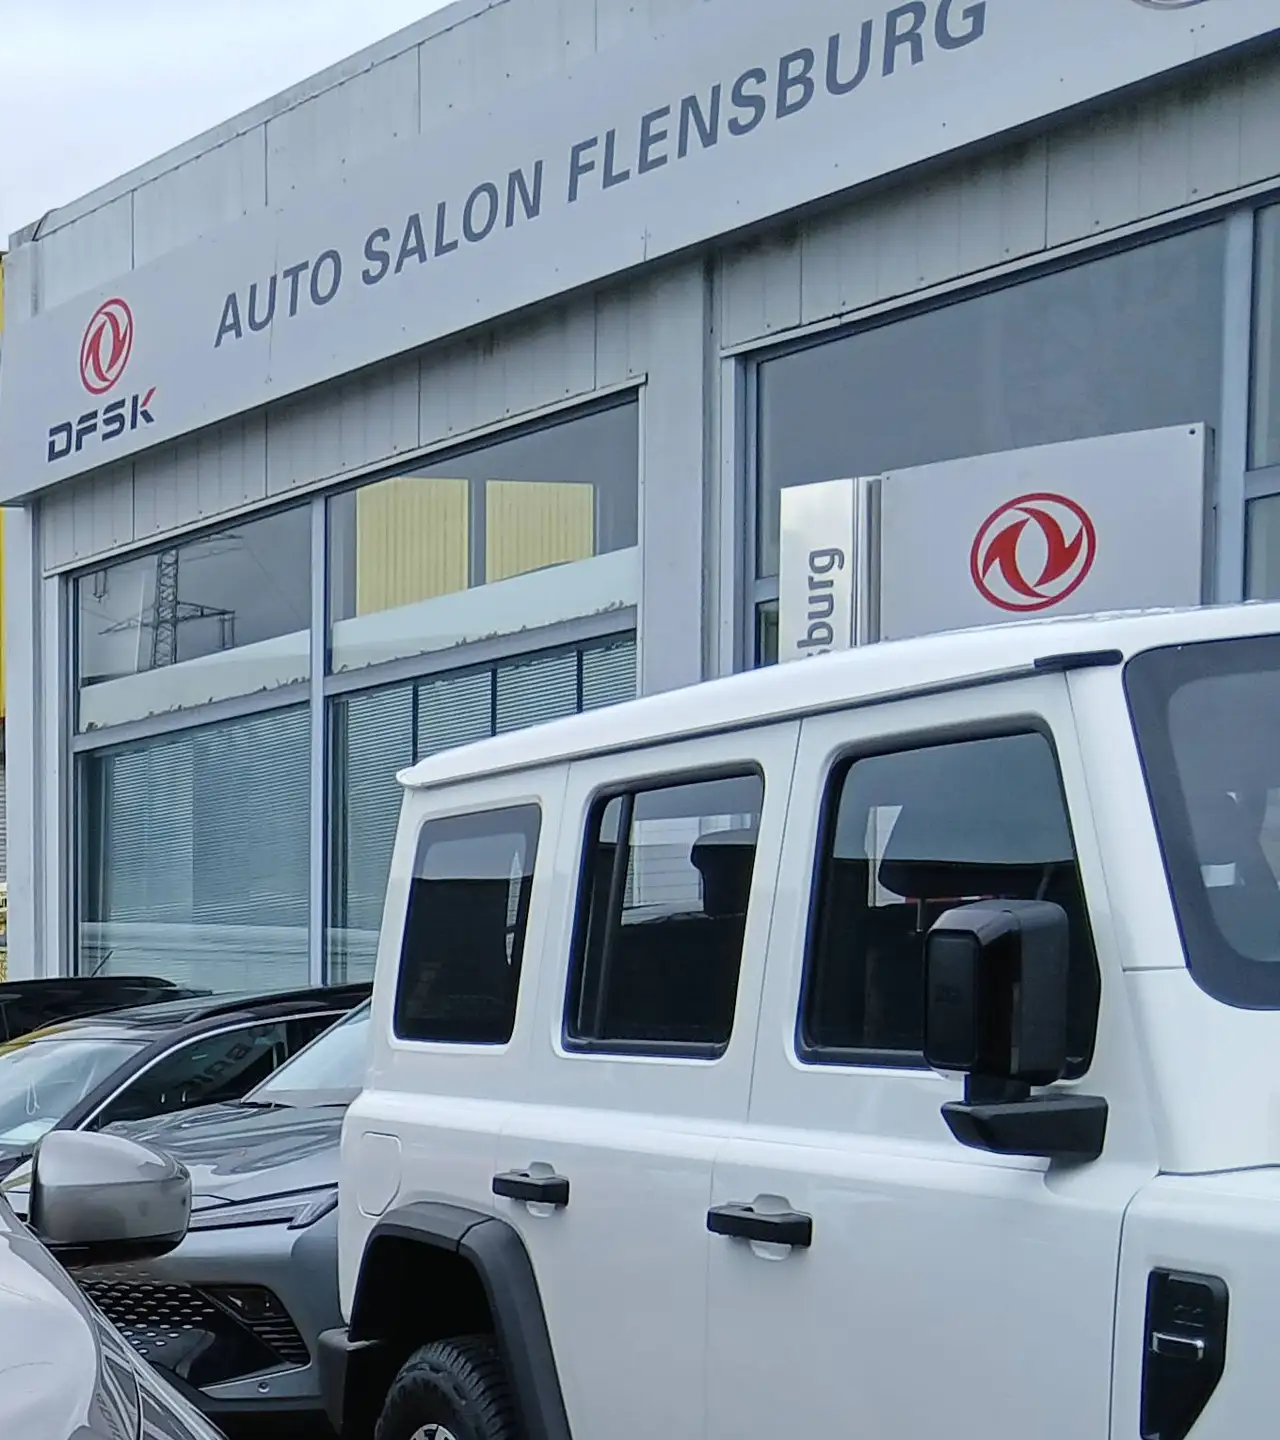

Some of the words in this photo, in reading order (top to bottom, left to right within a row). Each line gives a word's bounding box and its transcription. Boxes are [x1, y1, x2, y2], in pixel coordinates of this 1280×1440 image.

[214, 248, 342, 349] AUTO
[361, 159, 543, 286] SALON
[567, 0, 987, 203] FLENSBURG
[47, 386, 157, 463] DFSK
[796, 547, 845, 658] burg
